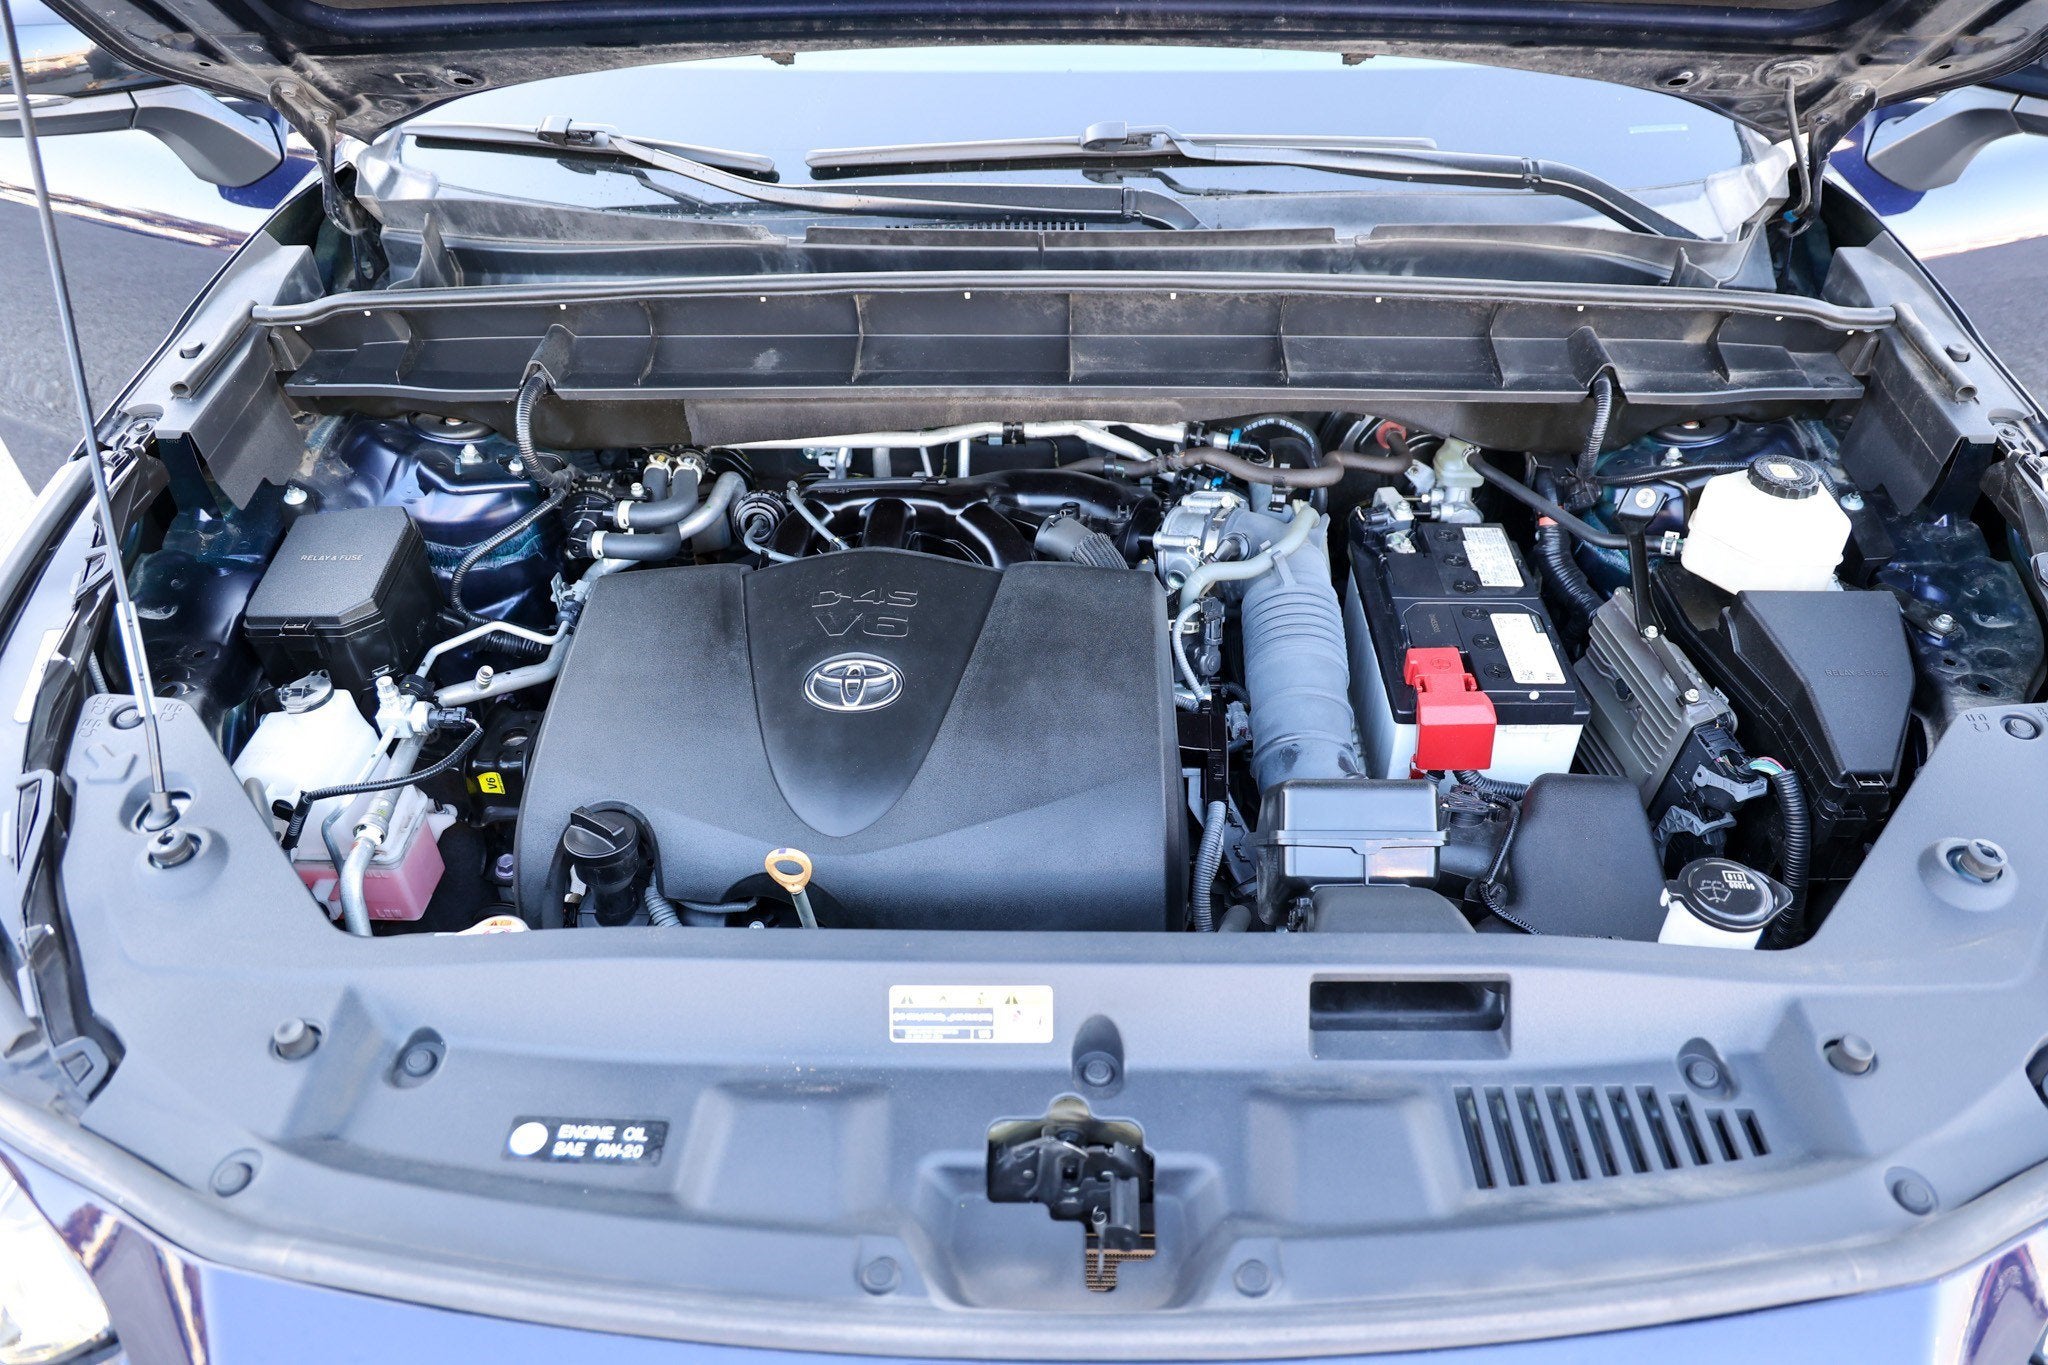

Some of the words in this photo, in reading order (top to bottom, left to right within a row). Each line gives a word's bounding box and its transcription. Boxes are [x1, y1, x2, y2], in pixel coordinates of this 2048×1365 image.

[812, 588, 919, 608] D-4S
[814, 612, 910, 638] V6
[486, 777, 498, 789] V6
[376, 909, 403, 918] LOW
[557, 1124, 616, 1141] ENGINE
[622, 1126, 649, 1142] OIL
[552, 1141, 587, 1157] SAE
[594, 1143, 645, 1159] 0W-20
